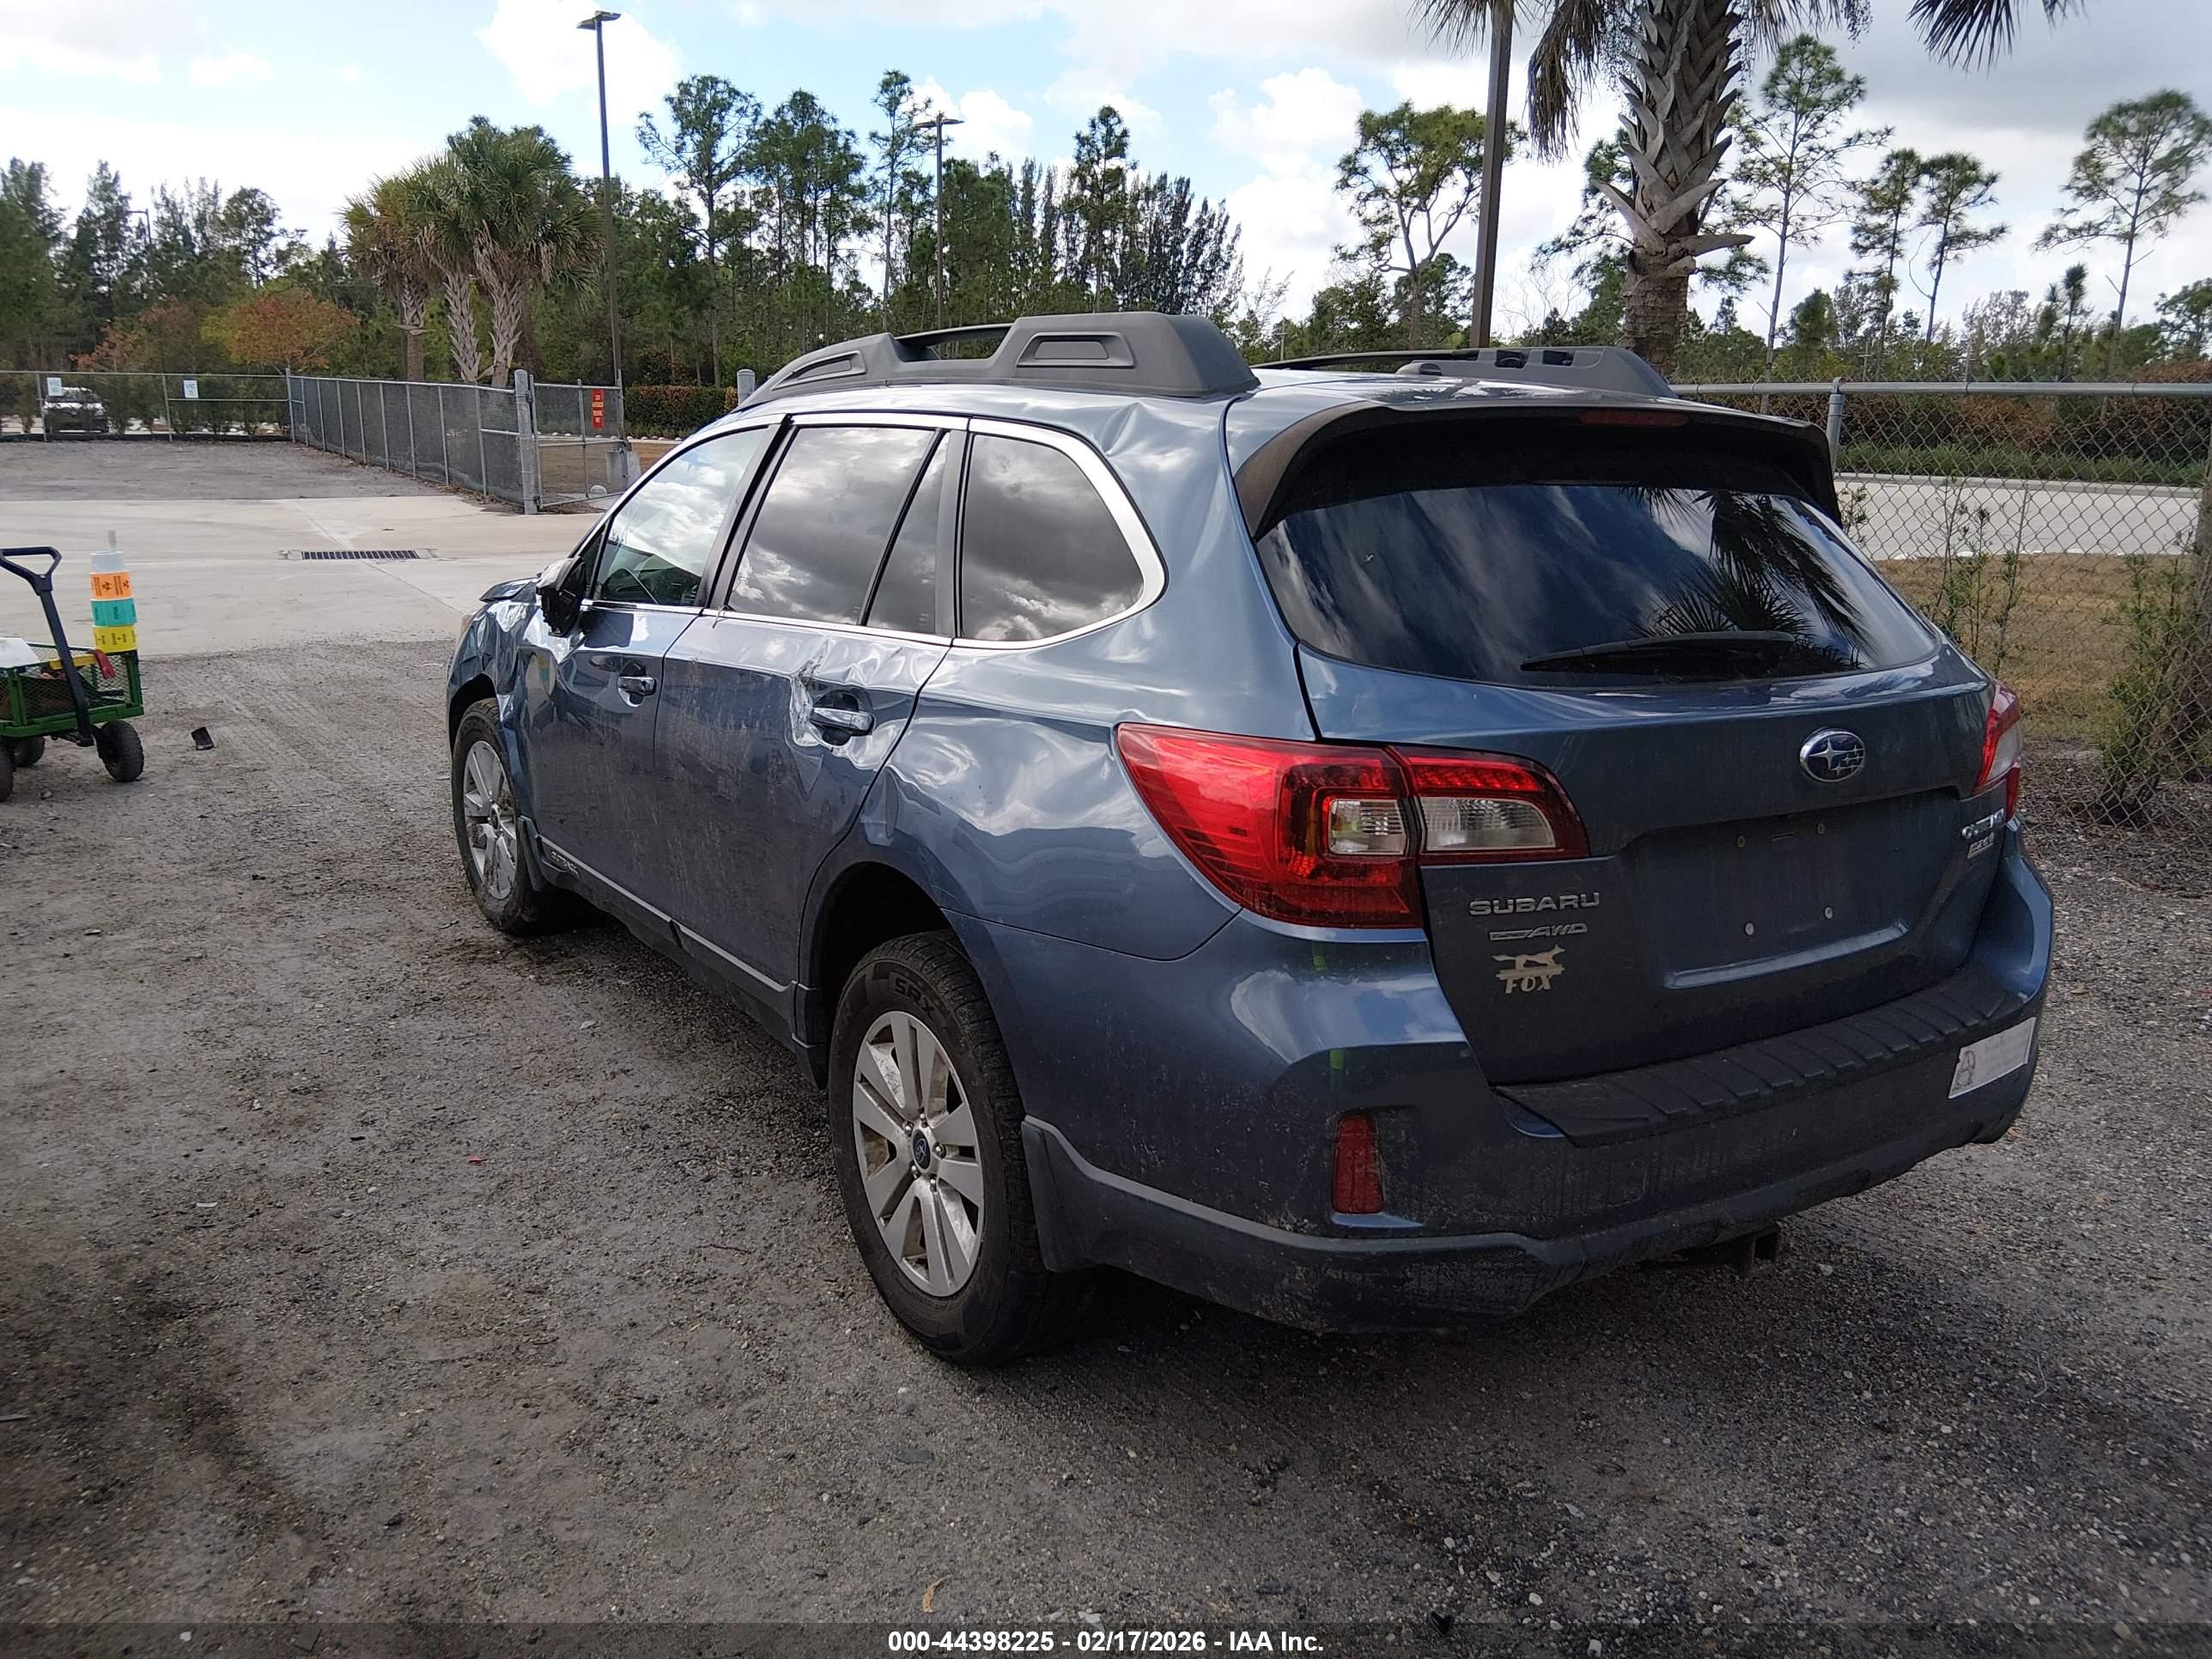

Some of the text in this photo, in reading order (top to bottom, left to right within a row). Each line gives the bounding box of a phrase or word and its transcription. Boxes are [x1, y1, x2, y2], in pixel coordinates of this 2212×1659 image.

[1469, 891, 1600, 916] SUBARU
[1525, 922, 1588, 939] AWD
[1504, 975, 1553, 994] FOX
[894, 976, 935, 1022] SRX
